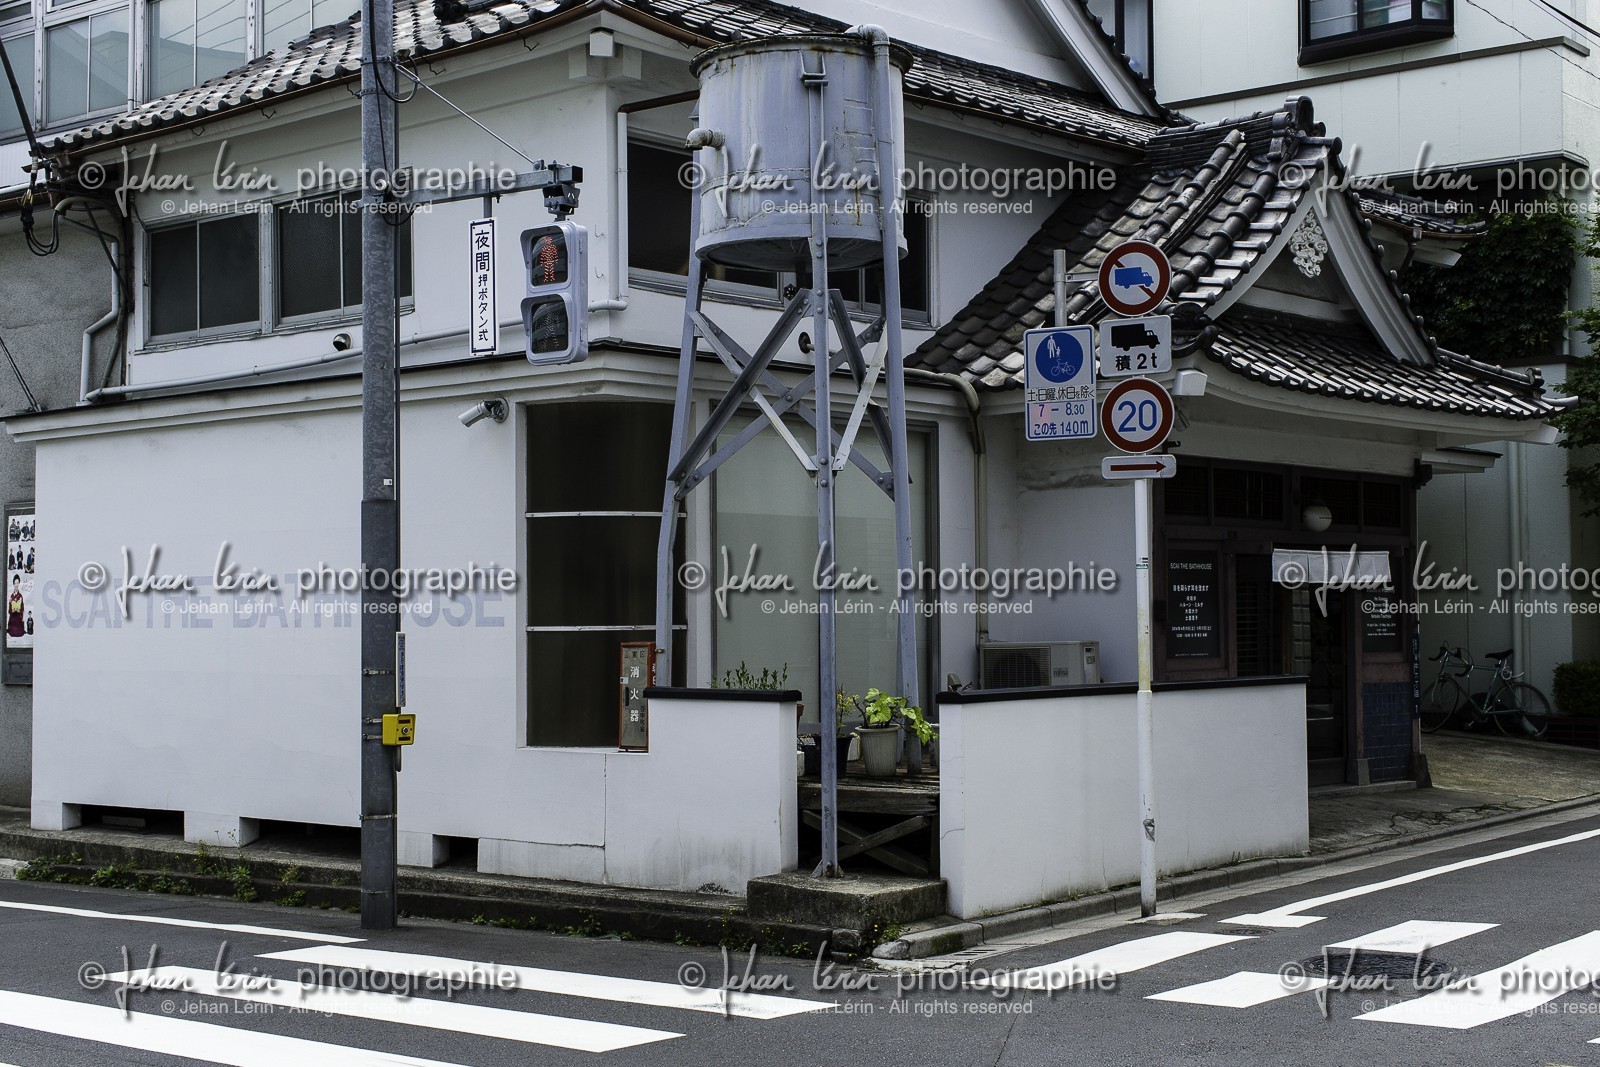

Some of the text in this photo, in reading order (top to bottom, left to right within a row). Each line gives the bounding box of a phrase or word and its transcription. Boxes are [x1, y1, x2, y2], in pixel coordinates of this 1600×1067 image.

[1116, 355, 1131, 371] 積
[1038, 404, 1045, 417] 7
[1117, 399, 1158, 433] 20
[1034, 420, 1089, 436] この先 140m
[41, 577, 122, 629] SCAI
[136, 575, 214, 629] THE
[630, 666, 639, 722] 消火器
